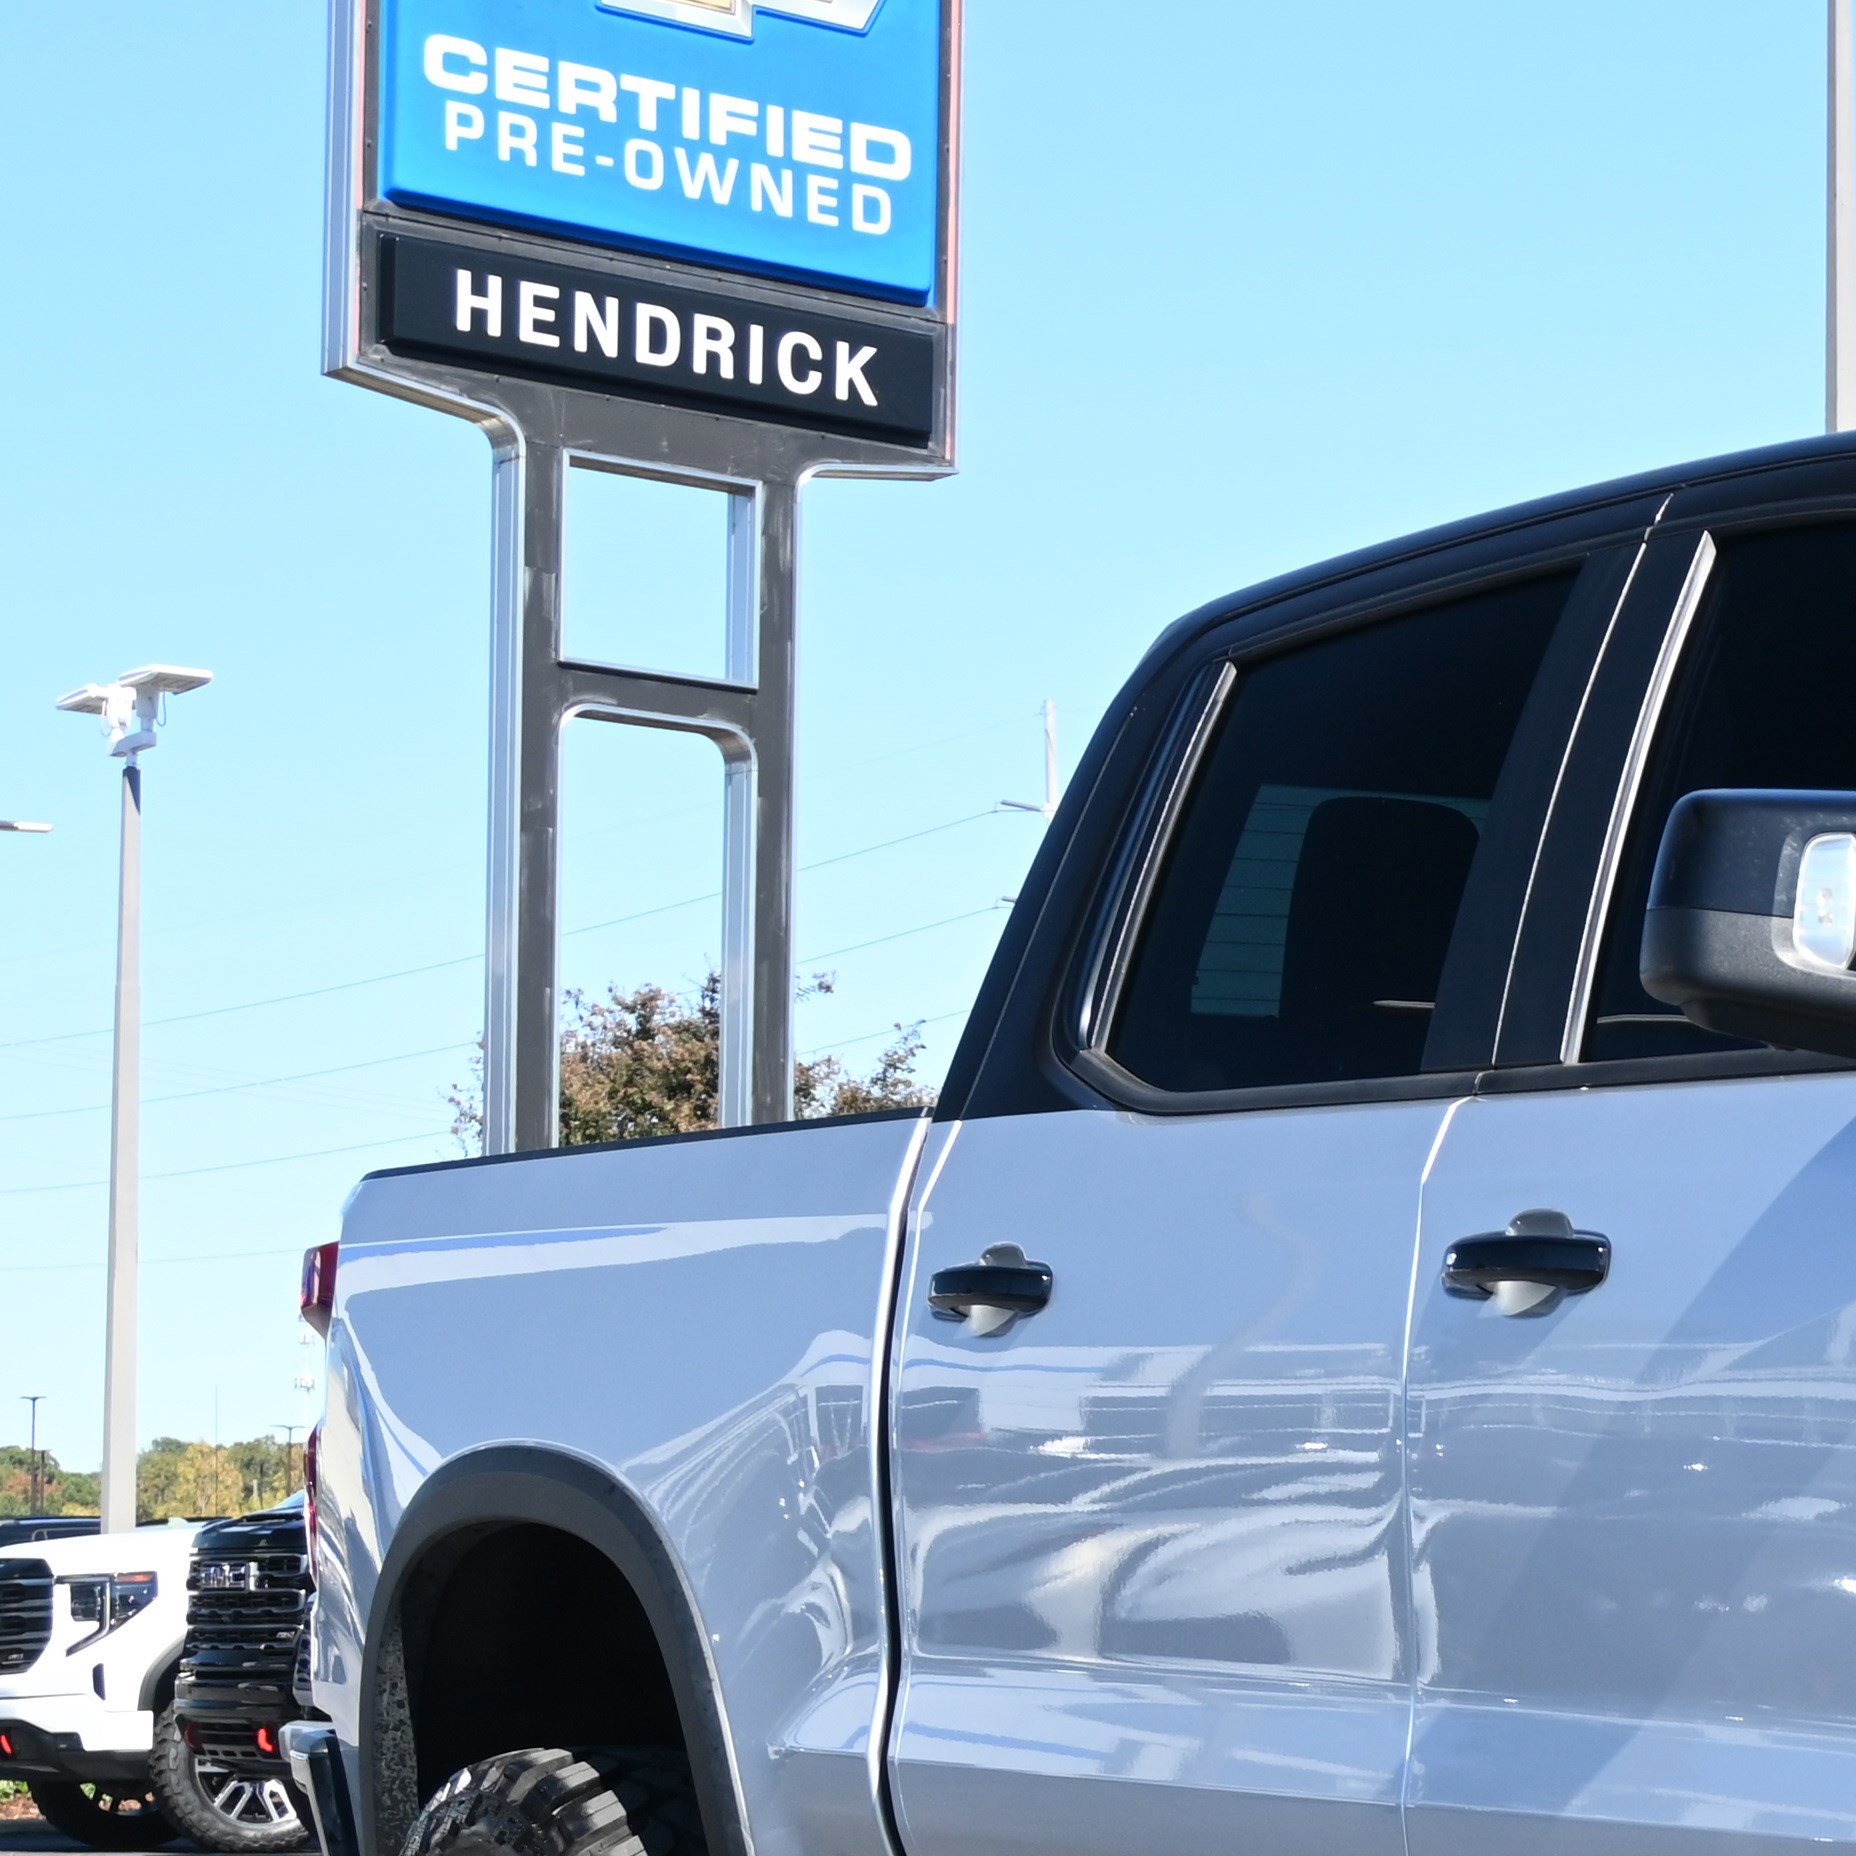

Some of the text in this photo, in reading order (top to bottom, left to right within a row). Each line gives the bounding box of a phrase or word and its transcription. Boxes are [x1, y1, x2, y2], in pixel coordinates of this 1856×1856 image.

[424, 34, 911, 181] CERTIFIED
[444, 100, 893, 236] PRE-OWNED
[456, 268, 879, 407] HENDRICK
